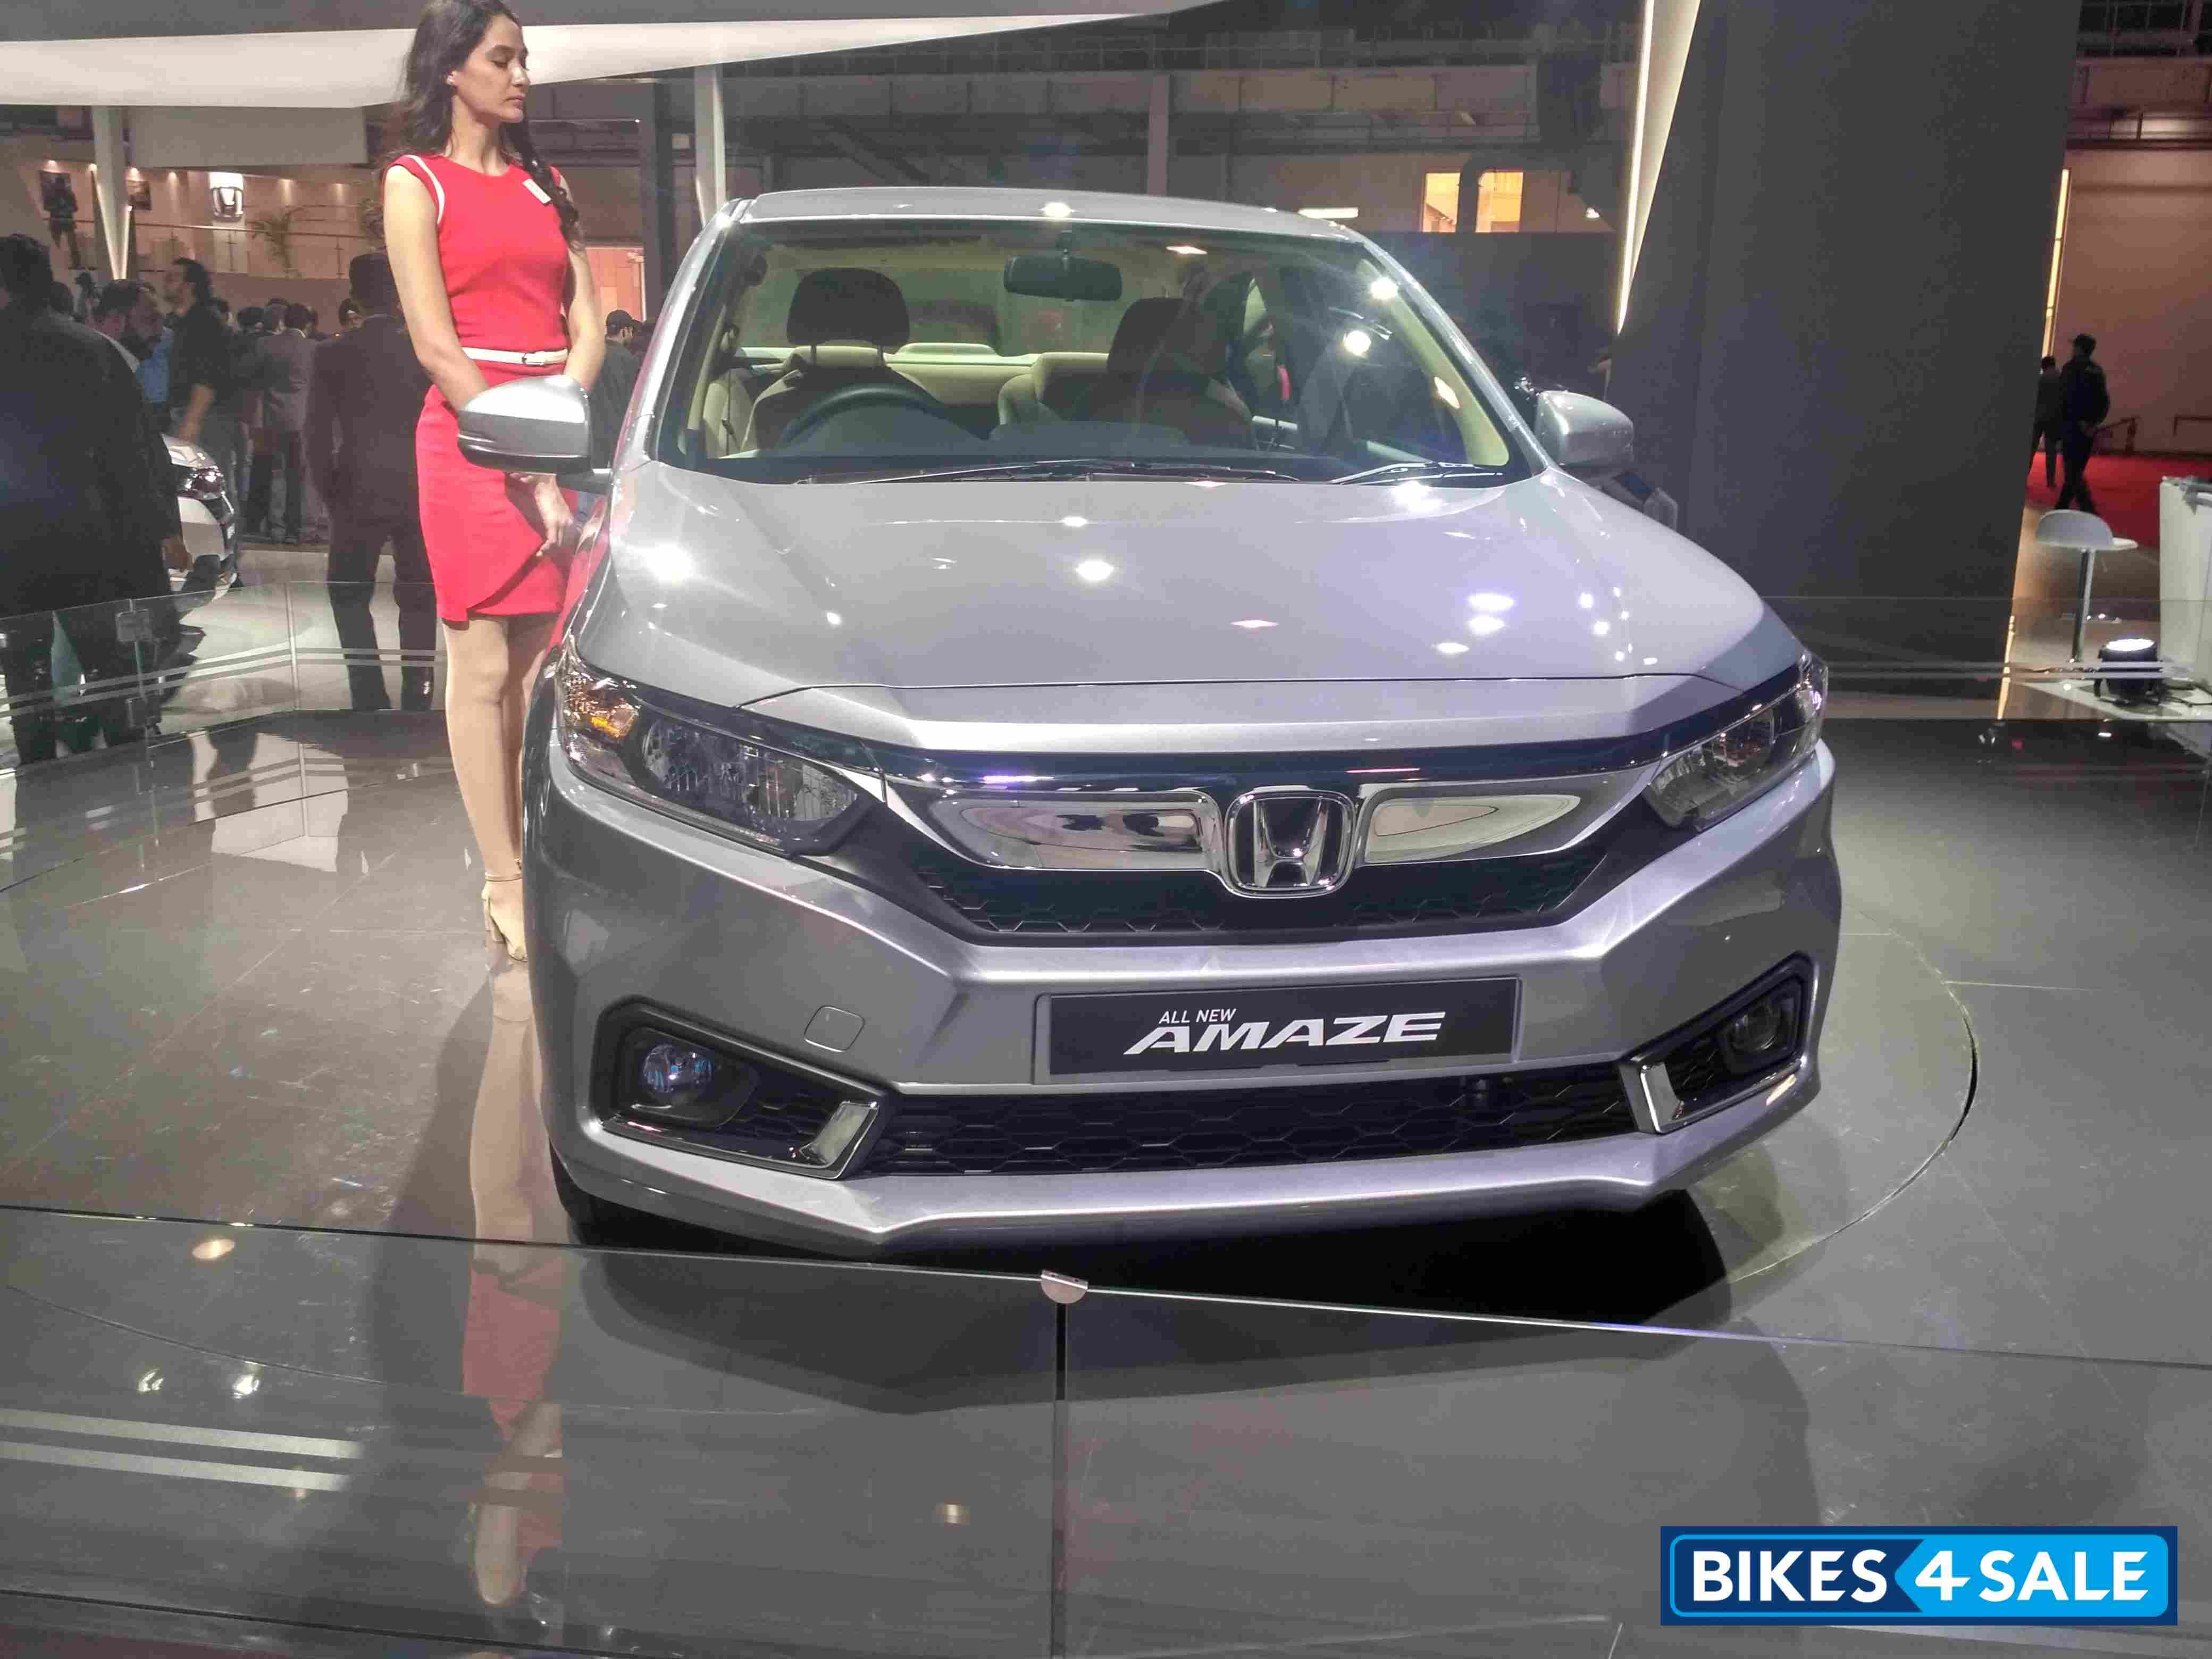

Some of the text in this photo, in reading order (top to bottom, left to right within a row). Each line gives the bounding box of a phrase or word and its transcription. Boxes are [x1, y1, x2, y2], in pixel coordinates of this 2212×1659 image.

[1158, 1008, 1237, 1025] ALL NEW
[1123, 1011, 1446, 1055] AMAZE
